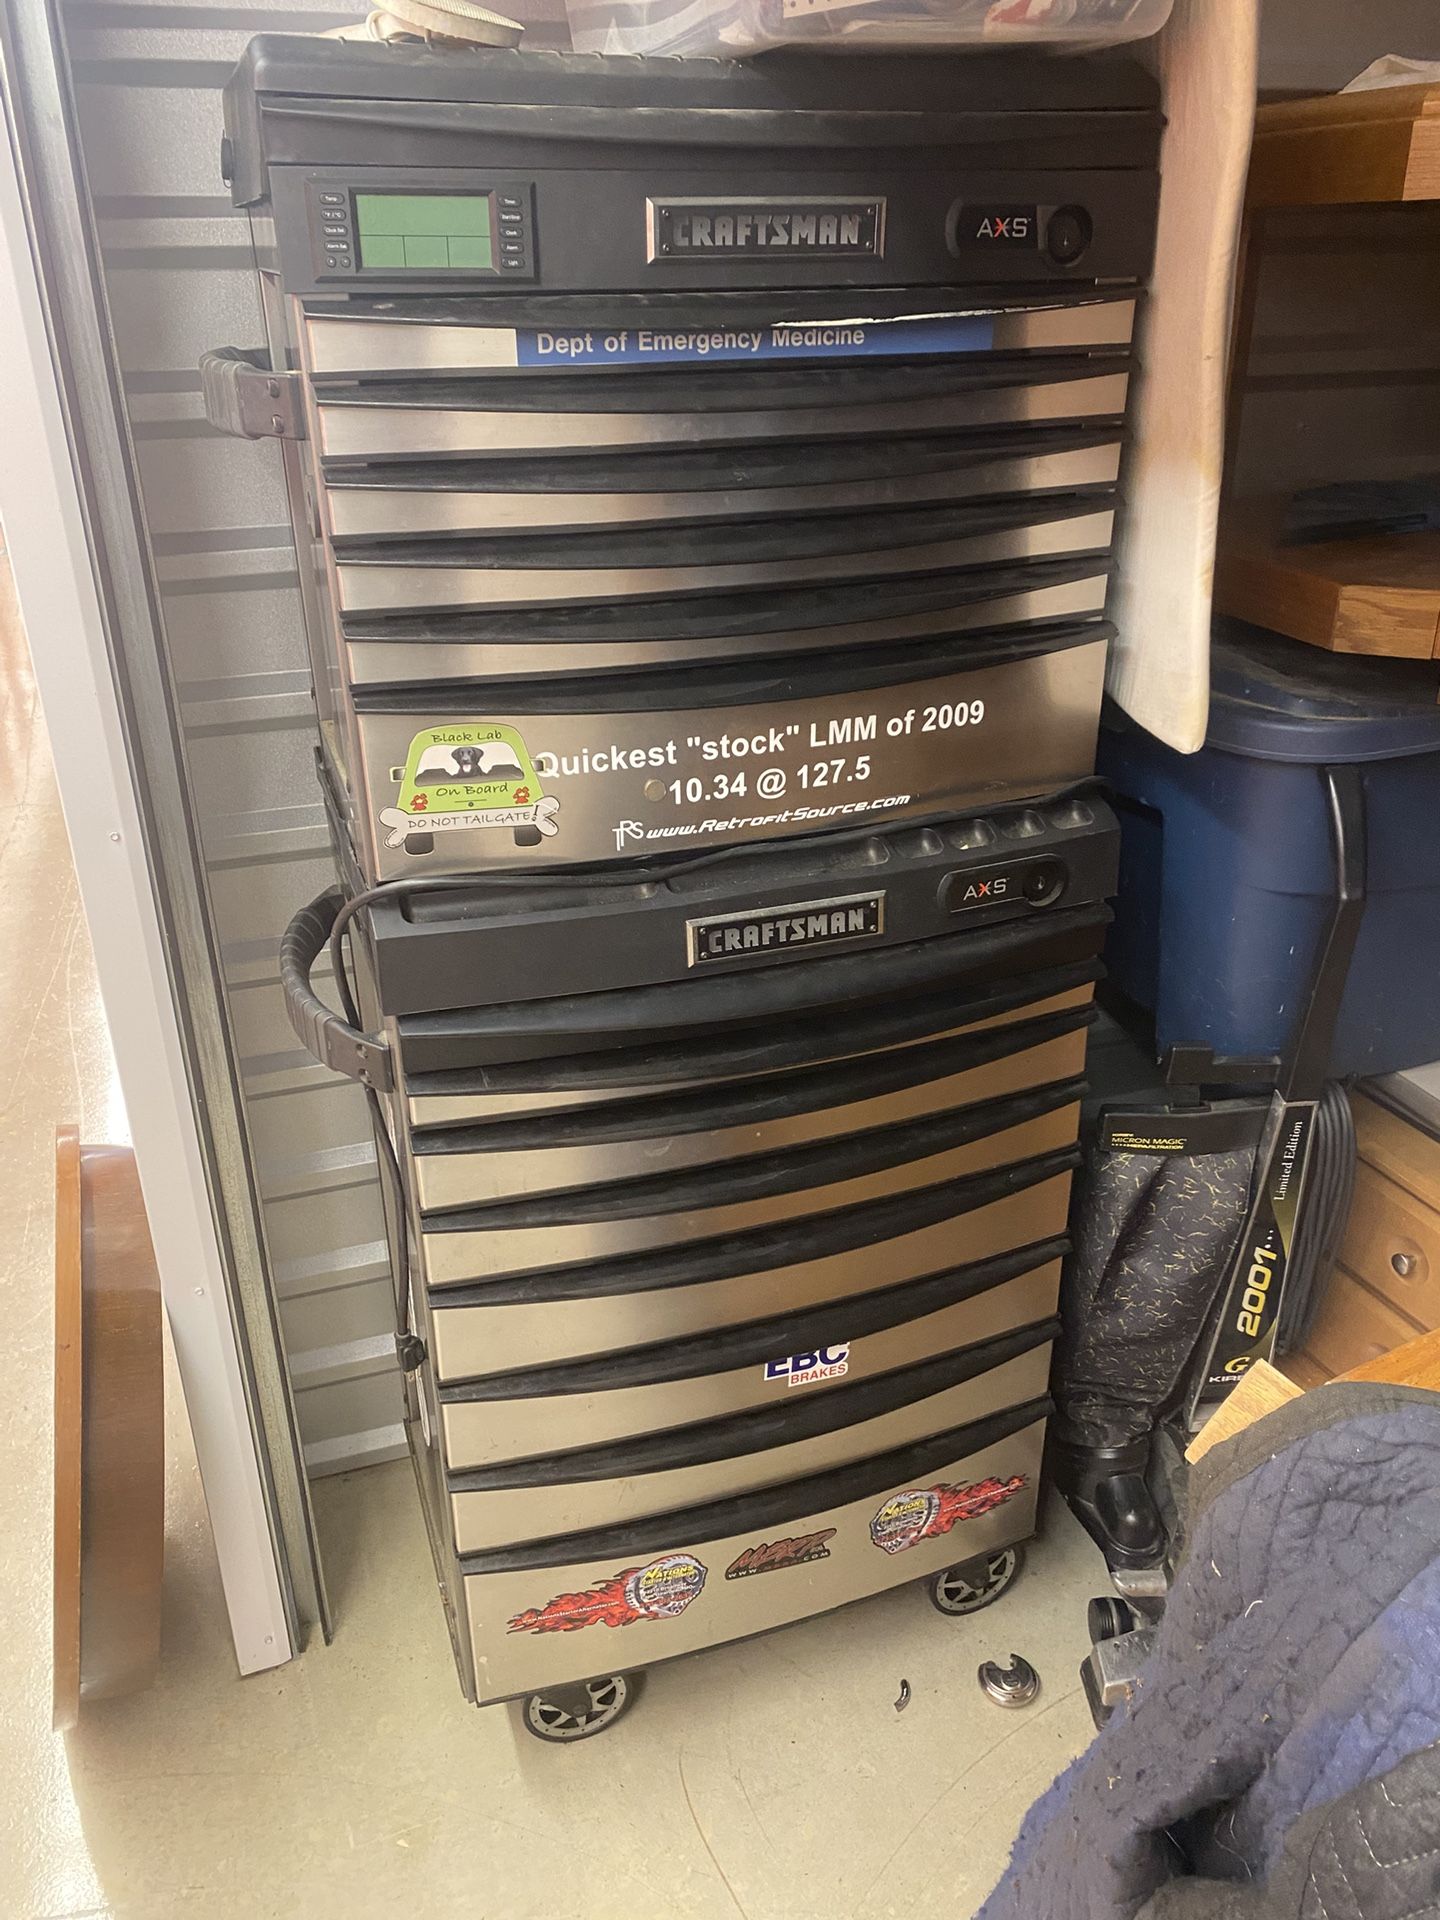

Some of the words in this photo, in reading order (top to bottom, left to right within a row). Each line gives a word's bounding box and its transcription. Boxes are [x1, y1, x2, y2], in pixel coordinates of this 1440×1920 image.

[673, 214, 860, 247] CRAFTSMAN
[977, 217, 1028, 239] AXS
[536, 332, 594, 357] Dept
[603, 331, 628, 352] of
[638, 330, 763, 354] Emergency
[771, 328, 865, 347] Medicine
[431, 733, 474, 743] Black
[477, 730, 503, 740] Lab
[534, 741, 677, 778] Quickest
[686, 725, 800, 761] "stock"
[809, 715, 877, 748] LMM
[886, 708, 915, 737] of
[921, 700, 985, 732] 2009
[435, 786, 461, 797] On
[464, 782, 509, 794] Board
[668, 771, 748, 805] 10.34
[756, 768, 787, 800] @
[796, 755, 872, 789] 127.5
[407, 819, 427, 829] DO
[431, 816, 459, 827] NOT
[645, 794, 911, 839] www.RetrofitSource.com
[963, 878, 1007, 901] AXS
[708, 907, 866, 953] CRAFTSMAN
[1111, 1137, 1151, 1145] MICRON
[1283, 1120, 1304, 1160] Edition
[1273, 1160, 1294, 1201] Limited
[766, 1344, 848, 1378] EBC
[790, 1363, 846, 1385] BRAKES
